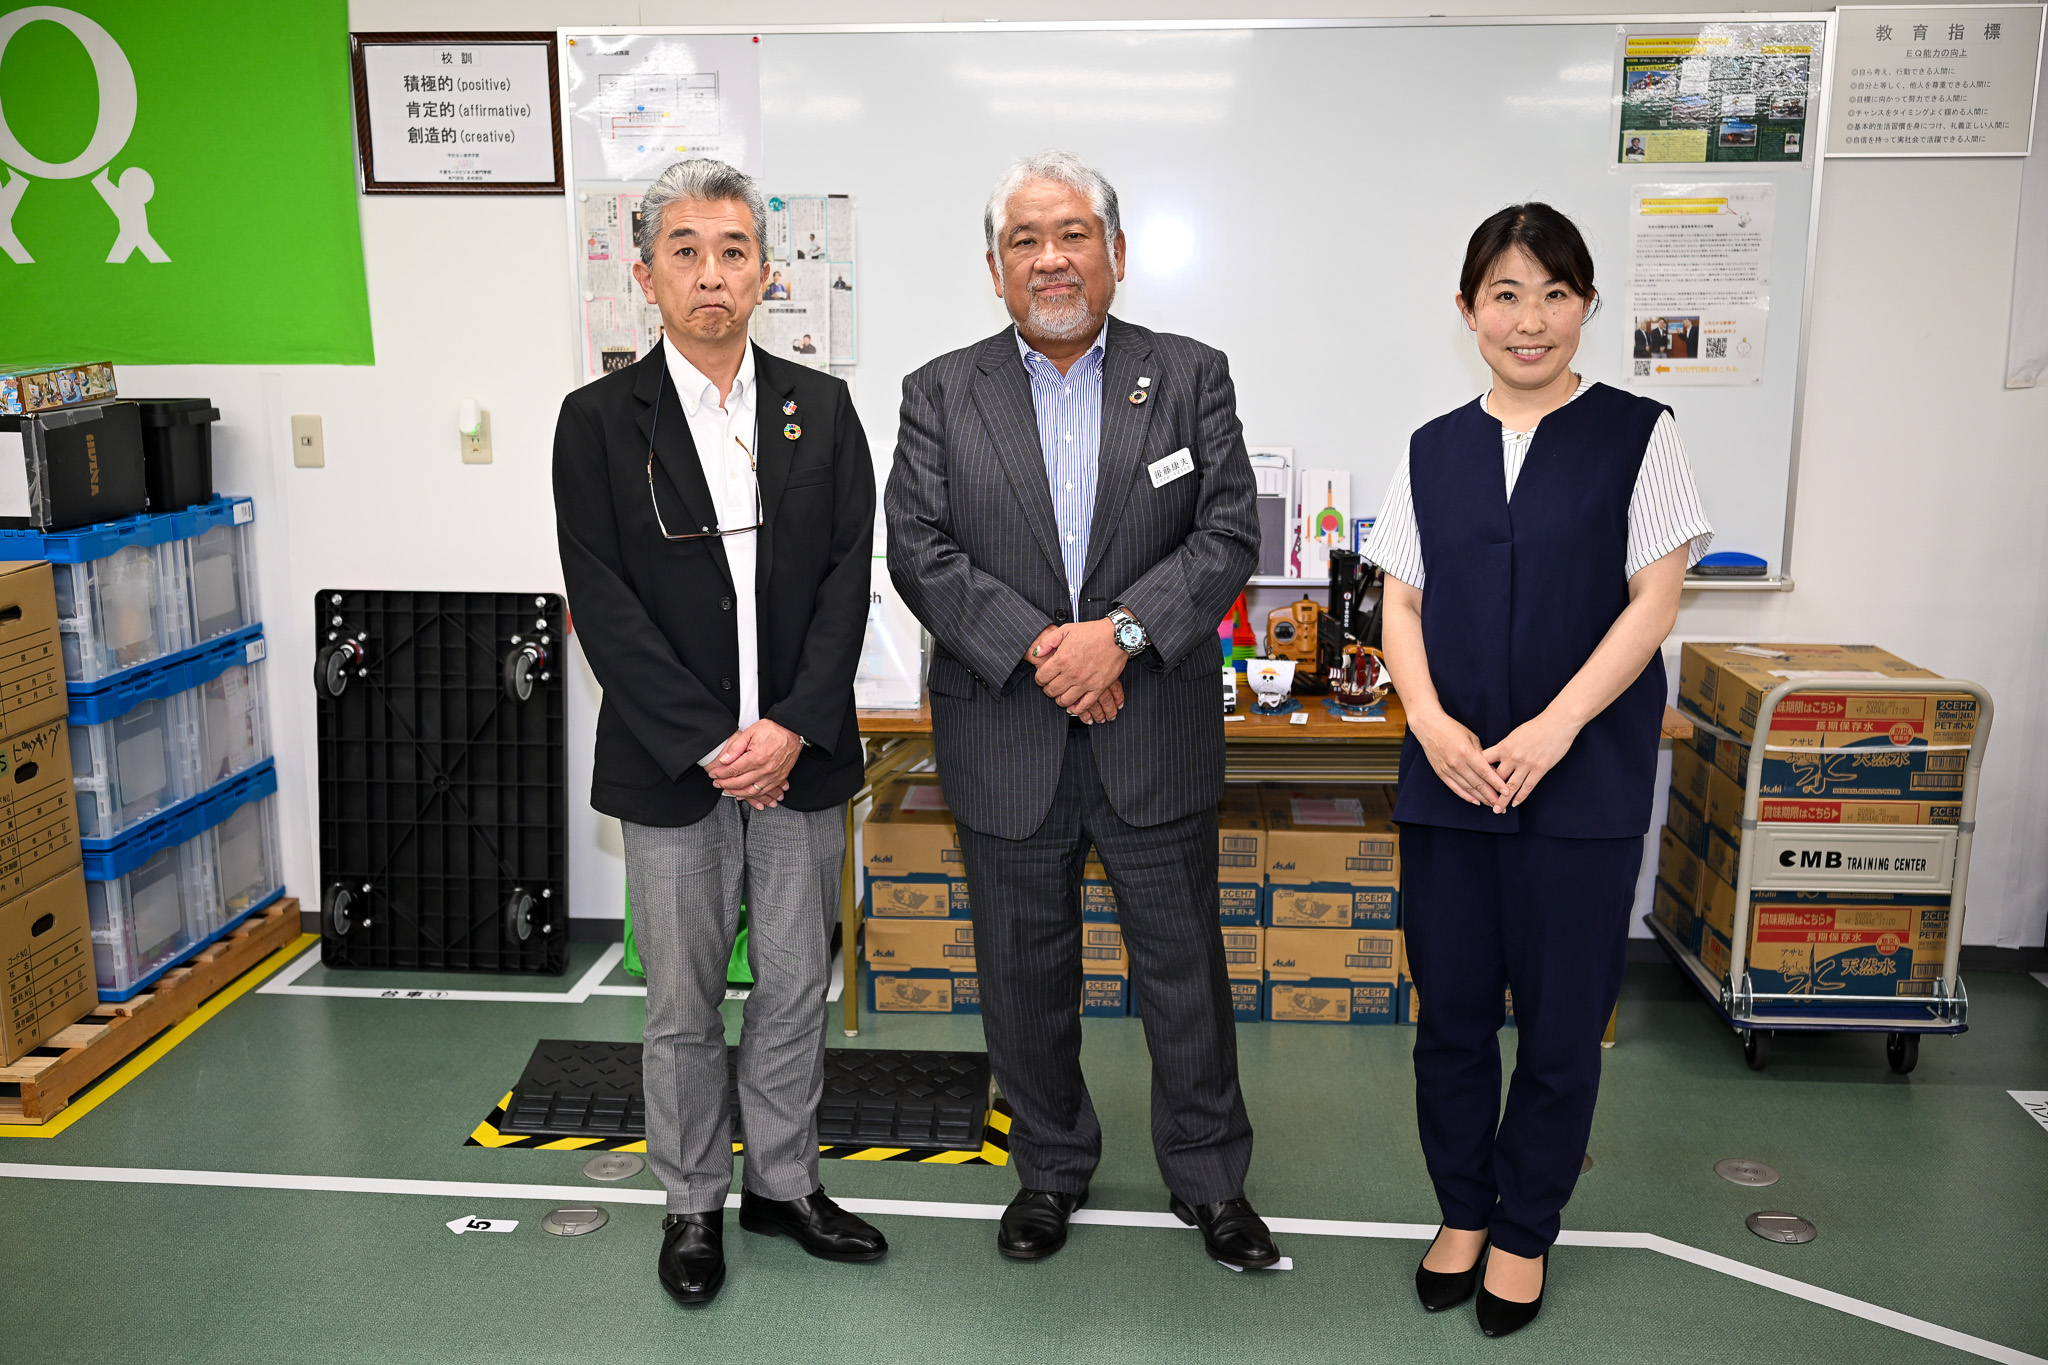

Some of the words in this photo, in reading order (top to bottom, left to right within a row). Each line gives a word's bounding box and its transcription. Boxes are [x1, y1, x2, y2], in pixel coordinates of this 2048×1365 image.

[1906, 48, 1967, 57] EQ能力の向上
[404, 75, 453, 92] 積極的
[457, 77, 511, 92] (positive)
[406, 101, 455, 118] 肯定的
[459, 104, 531, 118] (affirmative)
[408, 127, 457, 144] 創造的
[460, 130, 515, 144] (creative)
[47, 673, 51, 681] 日
[48, 686, 53, 694] 日
[1773, 700, 1835, 714] 味期限はこちら
[1939, 701, 1974, 710] 2CEH7
[1938, 711, 1958, 719] 500ml
[1816, 721, 1874, 731] 長期保存水
[1934, 722, 1974, 730] PETボトル
[1790, 738, 1813, 746] アサヒ
[1763, 805, 1831, 819] 賞味期限はこちら
[63, 835, 68, 843] 日
[870, 854, 893, 863] Asahi
[1272, 861, 1296, 870] Asahi
[1847, 857, 1889, 871] TRAINING
[1894, 858, 1927, 872] CENTER
[1222, 890, 1253, 898] 2CEH7
[1358, 893, 1389, 902] 2CEH7
[1219, 908, 1256, 916] PETボトル
[1354, 912, 1391, 920] PETボトル
[1760, 912, 1826, 926] 賞味期限はこちら
[1922, 921, 1941, 929] 500ml
[1806, 932, 1862, 942] 長期保存水
[1781, 948, 1804, 957] アサヒ
[1272, 959, 1295, 968] Asahi
[1840, 957, 1897, 976] 天然水
[77, 969, 82, 977] 日
[79, 982, 83, 990] 日
[1356, 988, 1387, 997] 2CEH7
[1085, 999, 1121, 1007] PETボトル
[1353, 1006, 1389, 1014] PETボトル
[466, 1219, 492, 1230] 5
